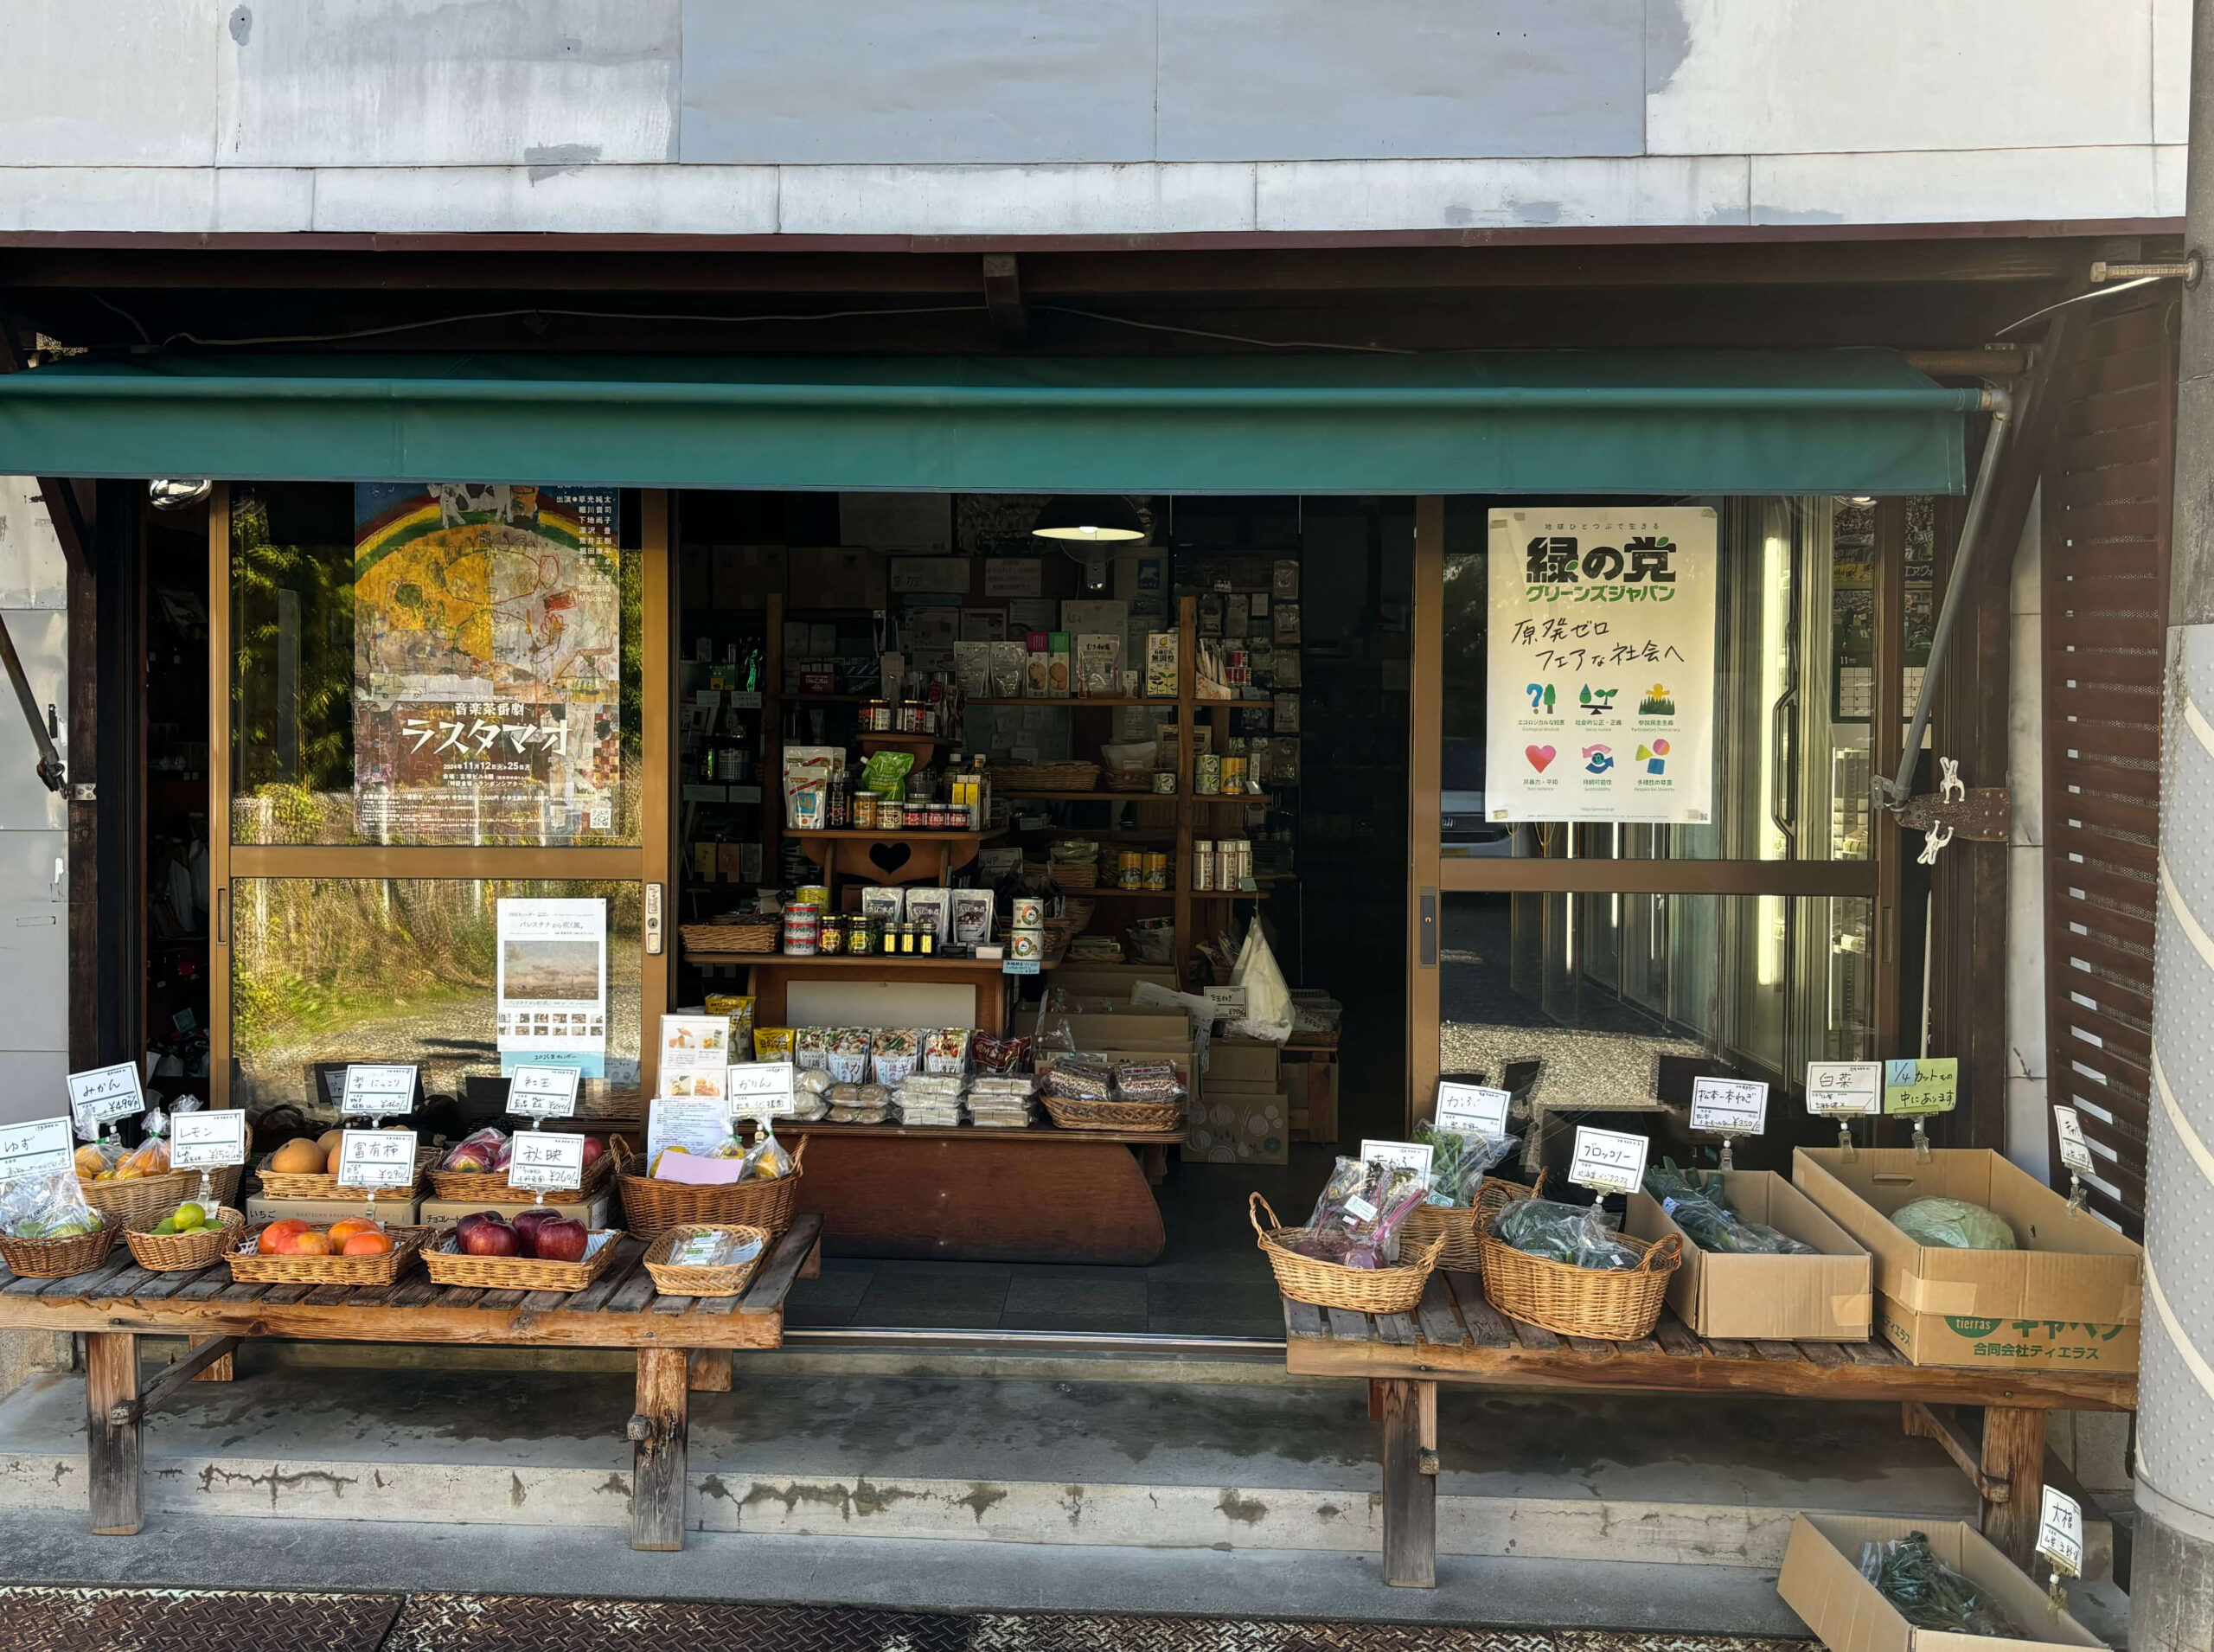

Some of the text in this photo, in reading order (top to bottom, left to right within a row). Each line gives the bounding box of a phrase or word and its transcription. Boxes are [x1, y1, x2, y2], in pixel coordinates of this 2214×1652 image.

[1526, 536, 1676, 582] 緑の党
[1526, 585, 1675, 603] グリーンズジャパン
[1511, 618, 1609, 645] 原発ゼロ
[1536, 639, 1685, 671] フェアな社会へ
[455, 702, 524, 716] 音楽茶番劇
[402, 719, 573, 757] ラスタマオ
[83, 1079, 121, 1097] みかん
[739, 1078, 771, 1090] かりん
[1820, 1073, 1852, 1089] 白菜
[1447, 1096, 1481, 1107] かぶ
[1698, 1089, 1756, 1105] 松本一本ねぎ
[180, 1127, 213, 1137] レモン
[4, 1136, 35, 1153] ゆず
[354, 1141, 399, 1158] 富有柿
[522, 1144, 562, 1162] 秋映
[1584, 1143, 1631, 1162] ブロッコリー
[250, 1210, 277, 1219] いちご
[1955, 1319, 1991, 1330] tierras
[1974, 1342, 2099, 1361] 合同会社ティエラス
[2052, 1502, 2073, 1530] 大根
